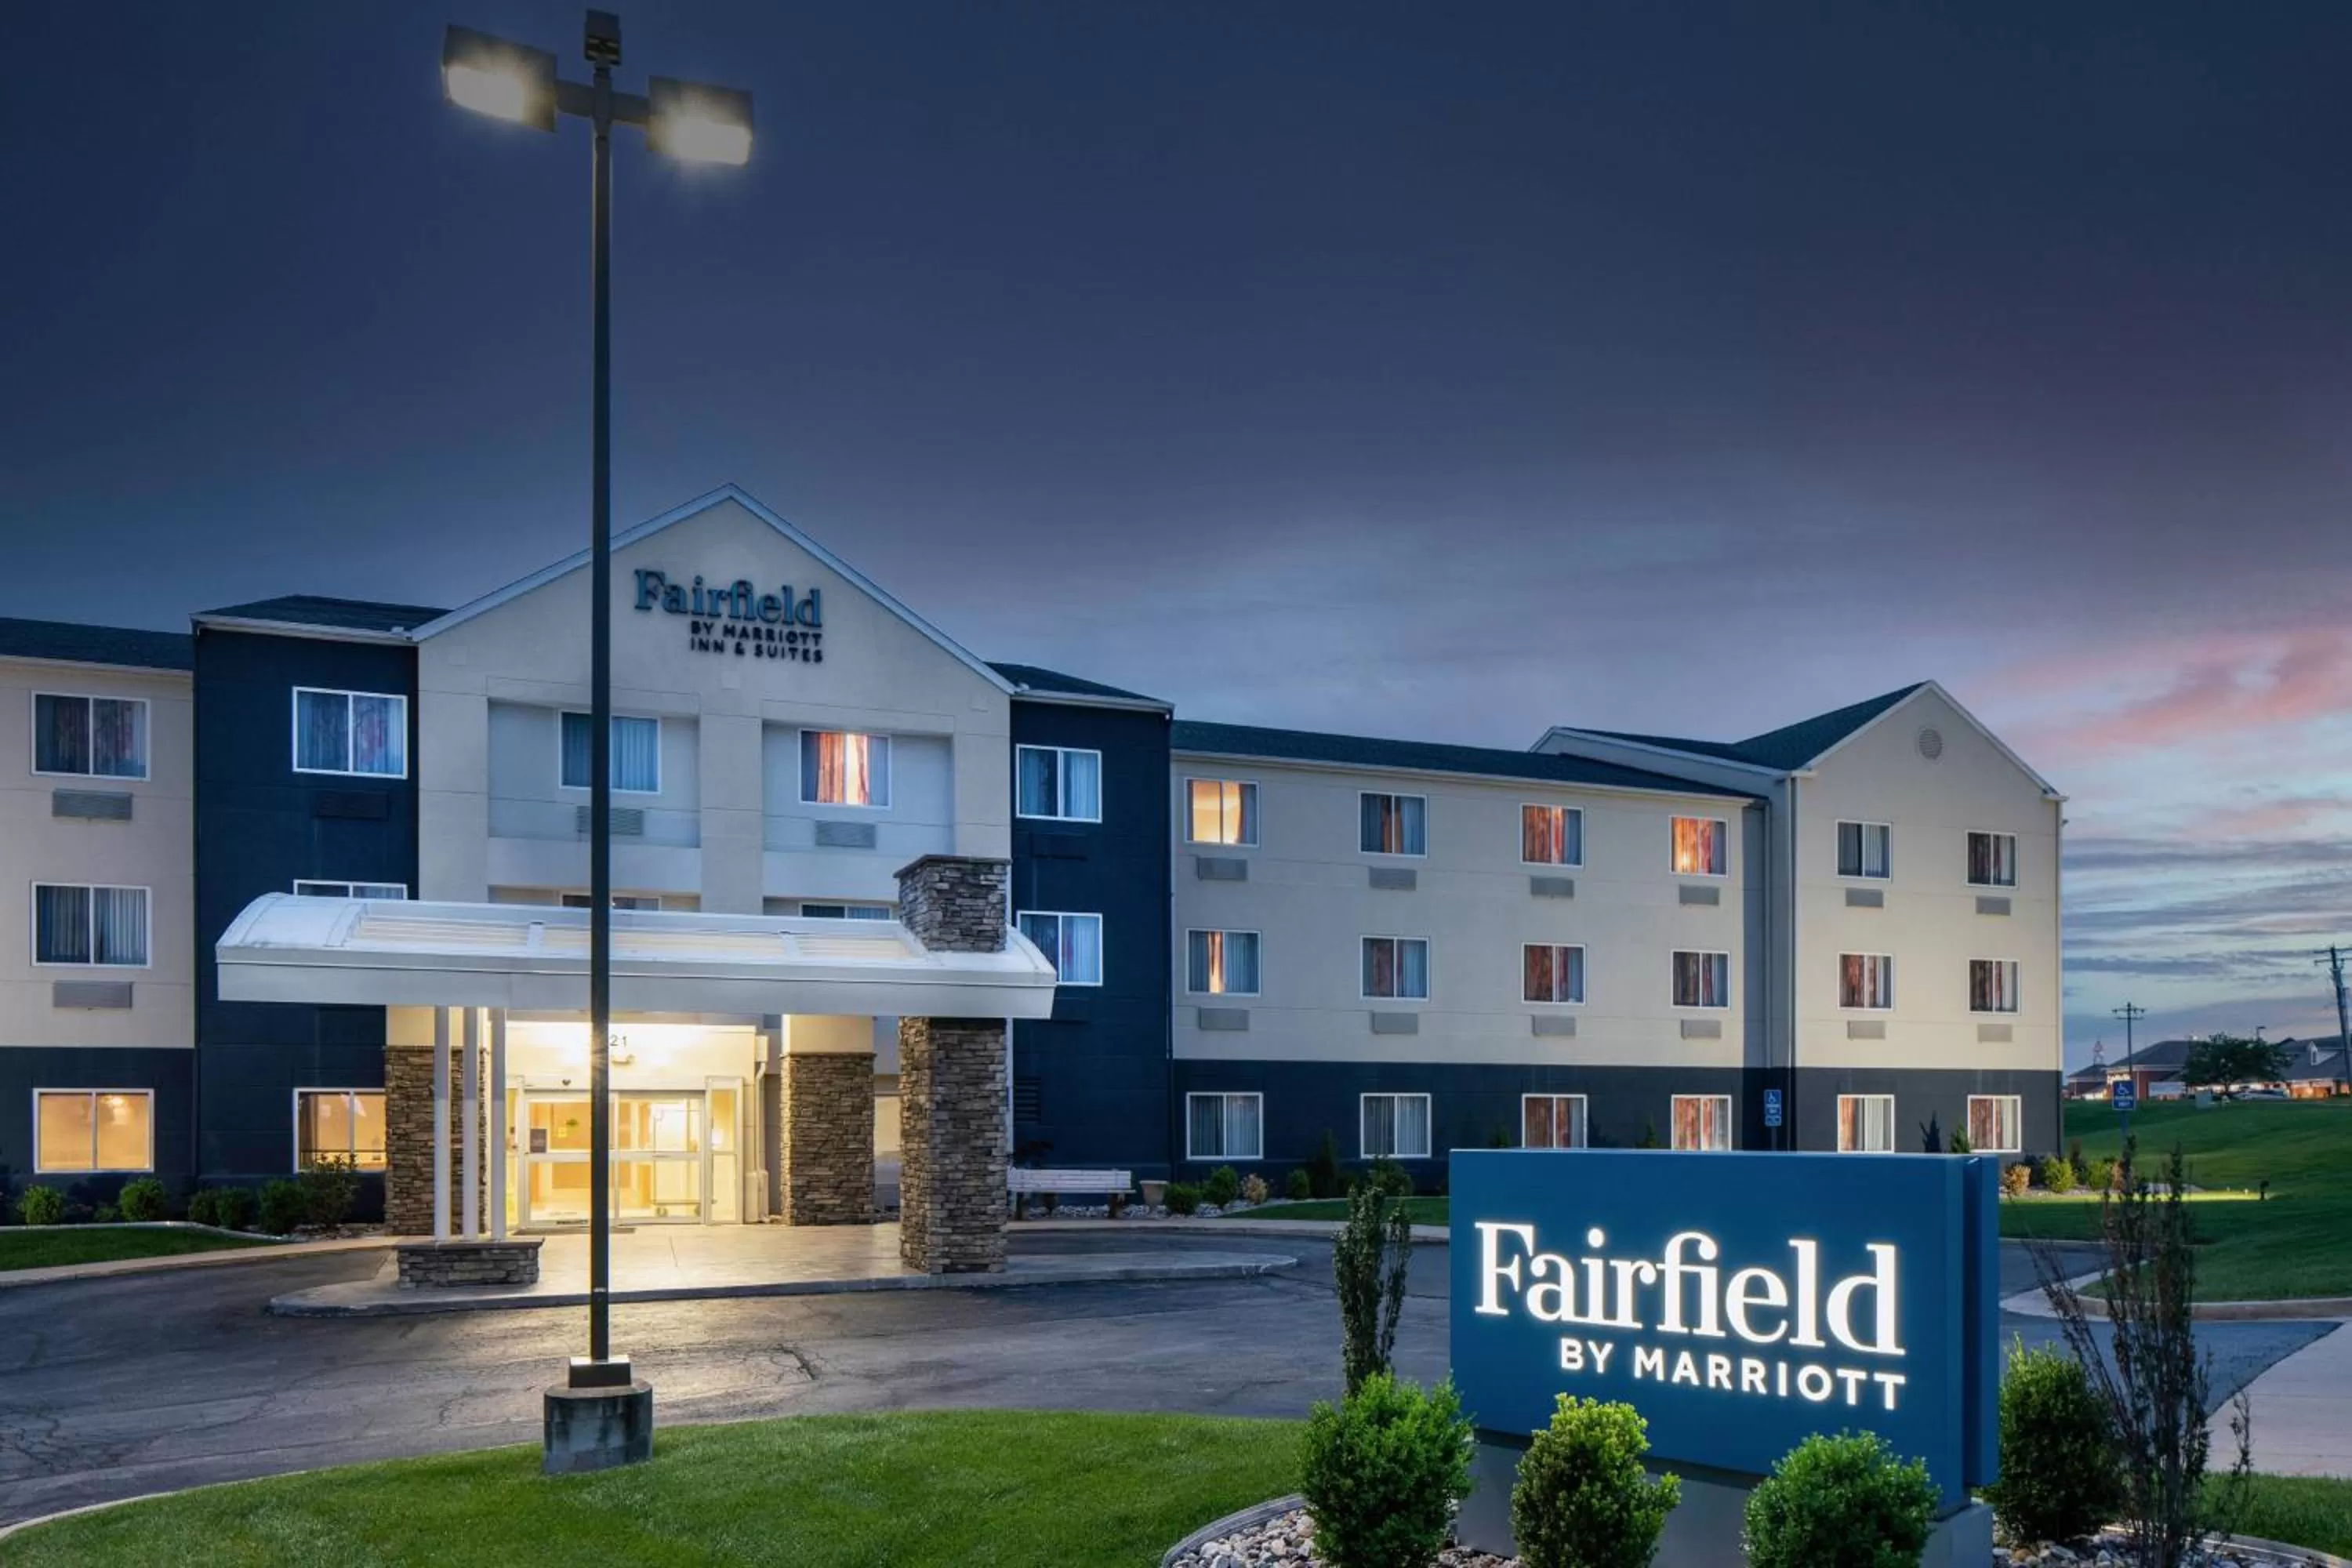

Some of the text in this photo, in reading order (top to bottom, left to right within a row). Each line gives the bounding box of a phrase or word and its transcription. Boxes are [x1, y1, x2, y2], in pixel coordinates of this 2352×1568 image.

[634, 568, 822, 629] Fairfield
[690, 637, 822, 663] INN & SUITES
[691, 620, 822, 647] BY MARRIOTT
[1474, 1221, 1906, 1356] Fairfield
[1559, 1338, 1907, 1411] BY MARRIOTT
